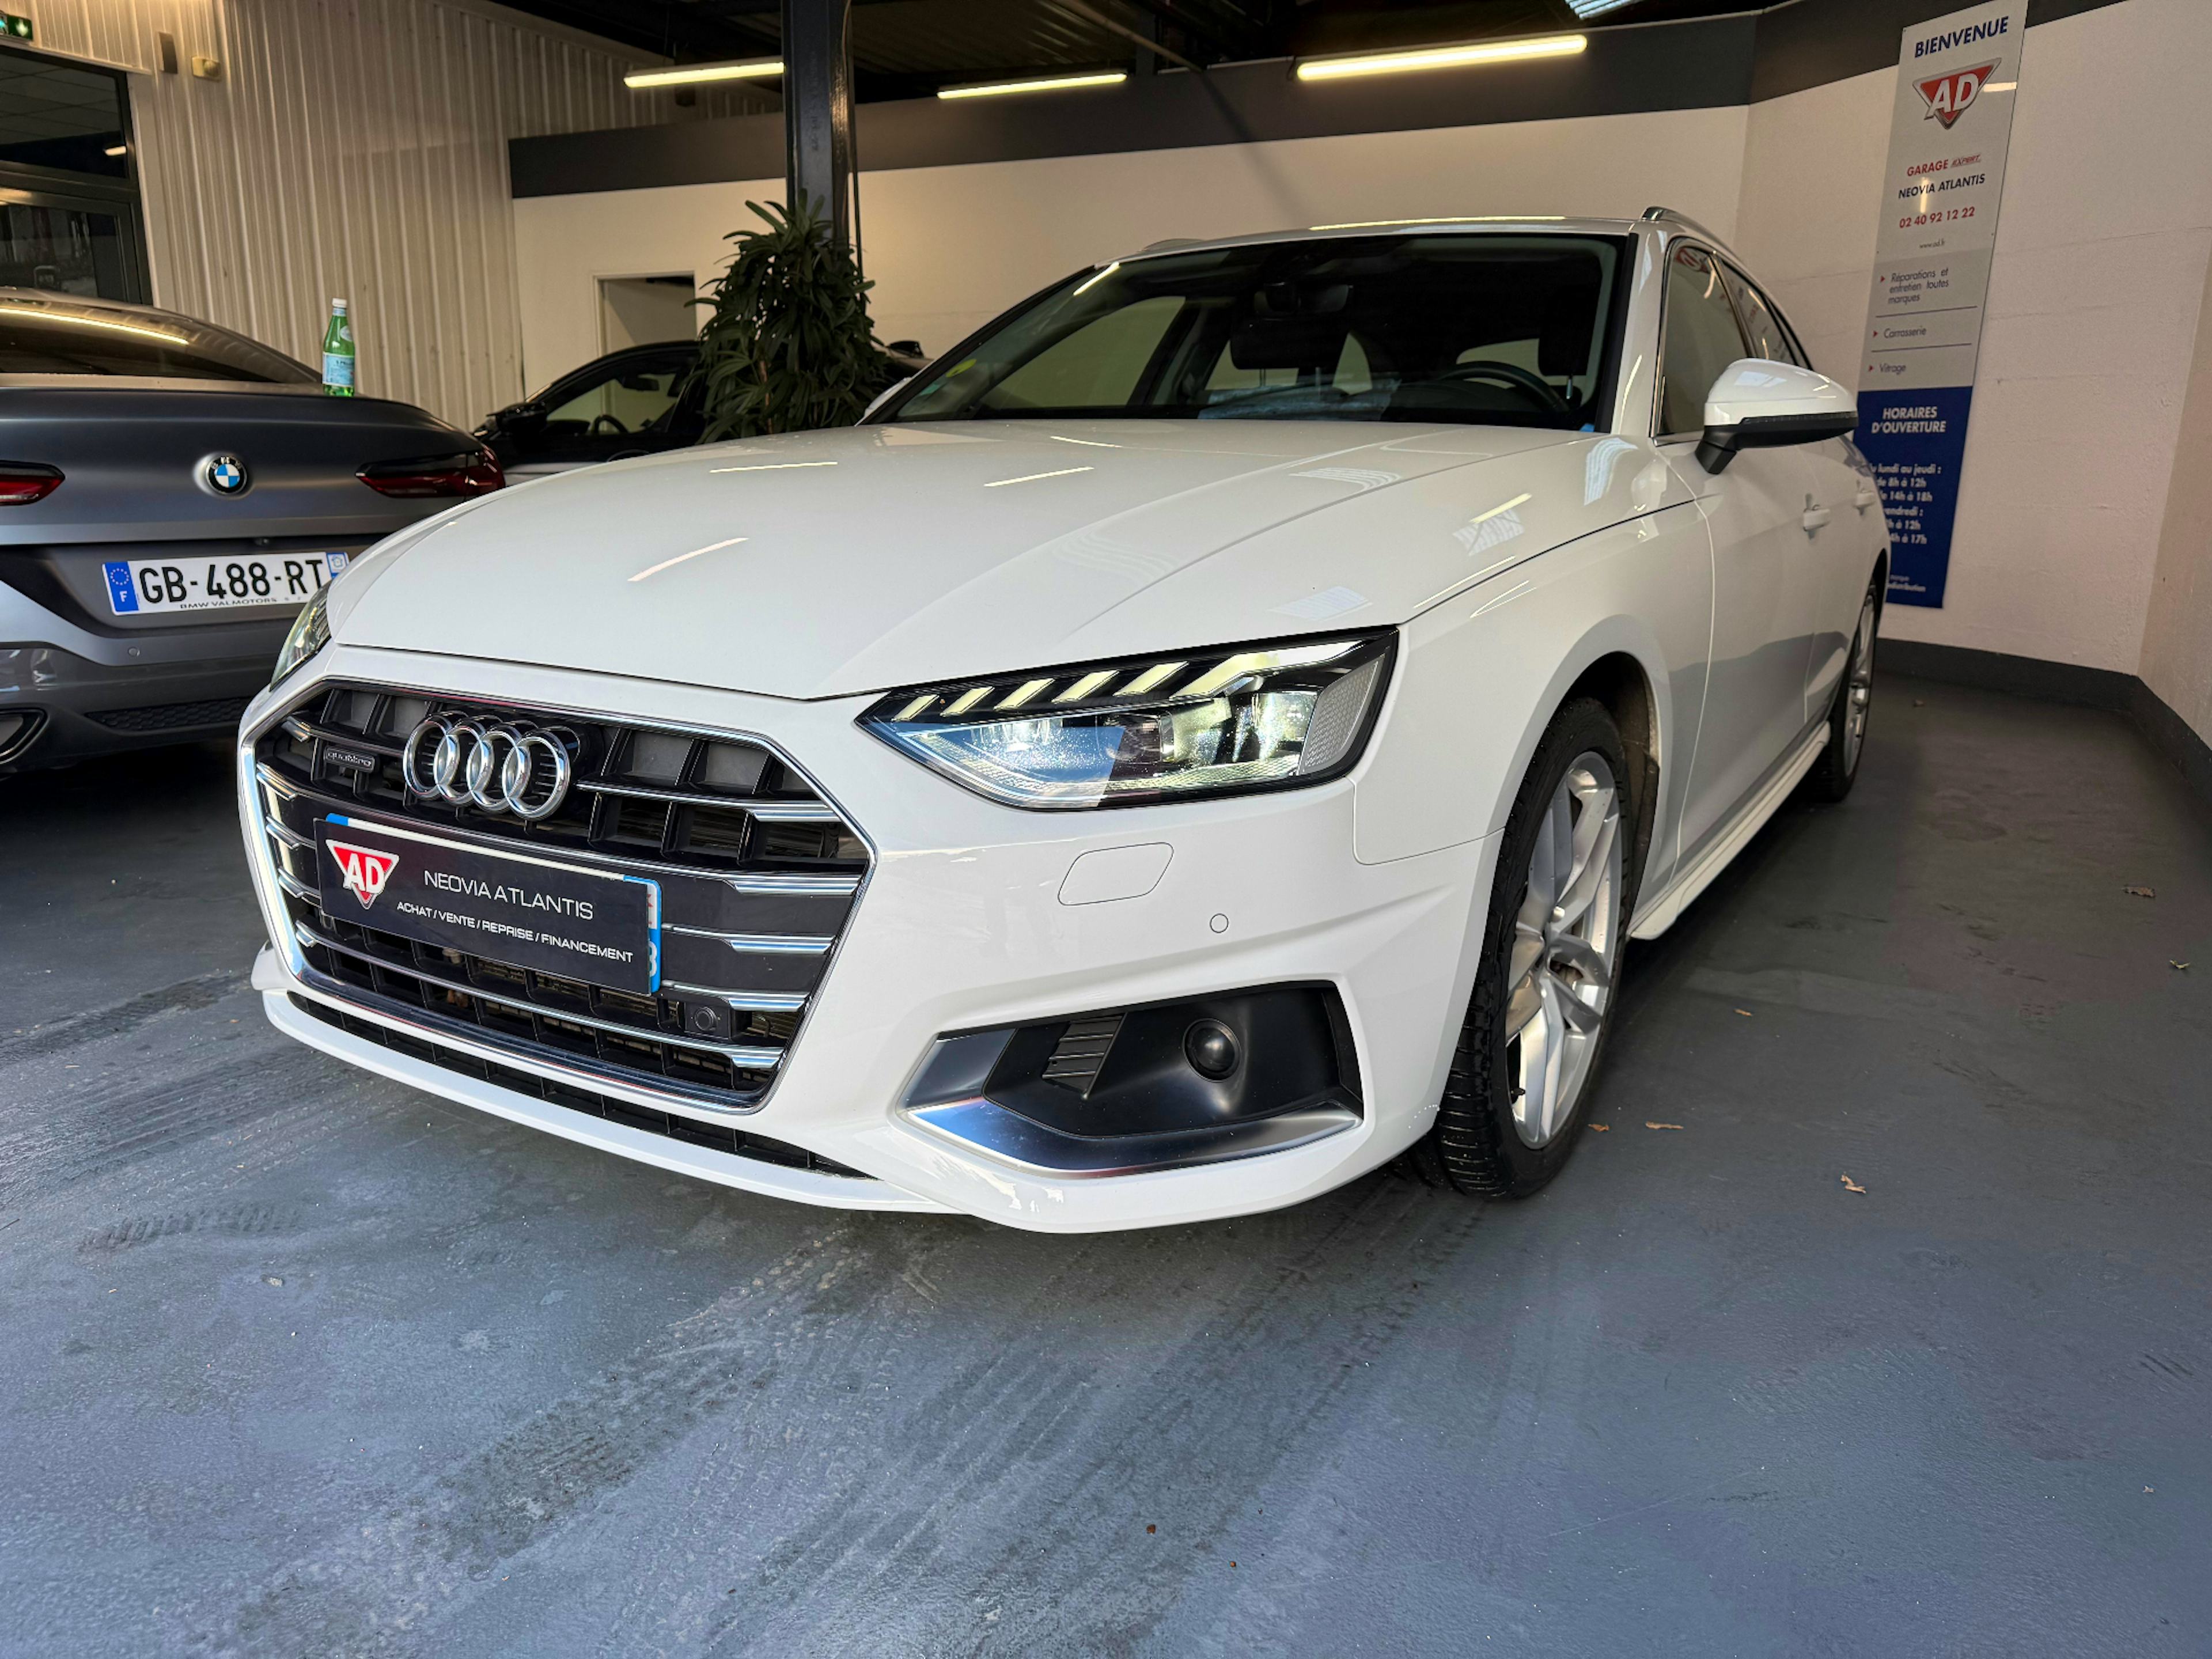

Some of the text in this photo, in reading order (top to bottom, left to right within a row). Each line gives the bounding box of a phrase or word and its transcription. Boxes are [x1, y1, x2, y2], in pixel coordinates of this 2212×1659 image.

[1914, 16, 2009, 58] BIENVENUE
[1929, 73, 1980, 119] AD
[1907, 159, 1949, 177] GARAGE
[1898, 173, 1986, 199] NEOVIA ATLANTIS
[1899, 206, 1975, 229] 02 40 92 12 22
[1941, 267, 1949, 276] et
[1889, 279, 1949, 294] entretien toutes
[1888, 294, 1921, 305] marques
[1880, 363, 1906, 375] Vitrage
[1883, 406, 1938, 420] HORAIRES
[1871, 421, 1946, 434] D'OUVERTURE
[1878, 463, 1900, 474] lundi
[1913, 463, 1936, 476] jeudi
[1910, 478, 1927, 488] 12h
[1911, 534, 1927, 544] 17h
[119, 560, 323, 604] F GB-488-RT
[180, 601, 209, 609] BMW
[342, 851, 385, 894] AD
[423, 869, 594, 921] NEOVIA ATLANTIS
[396, 901, 432, 918] ACHAT
[438, 910, 476, 929] VENTE
[482, 921, 534, 941] REPRISE
[540, 933, 634, 963] FINANCEMENT
